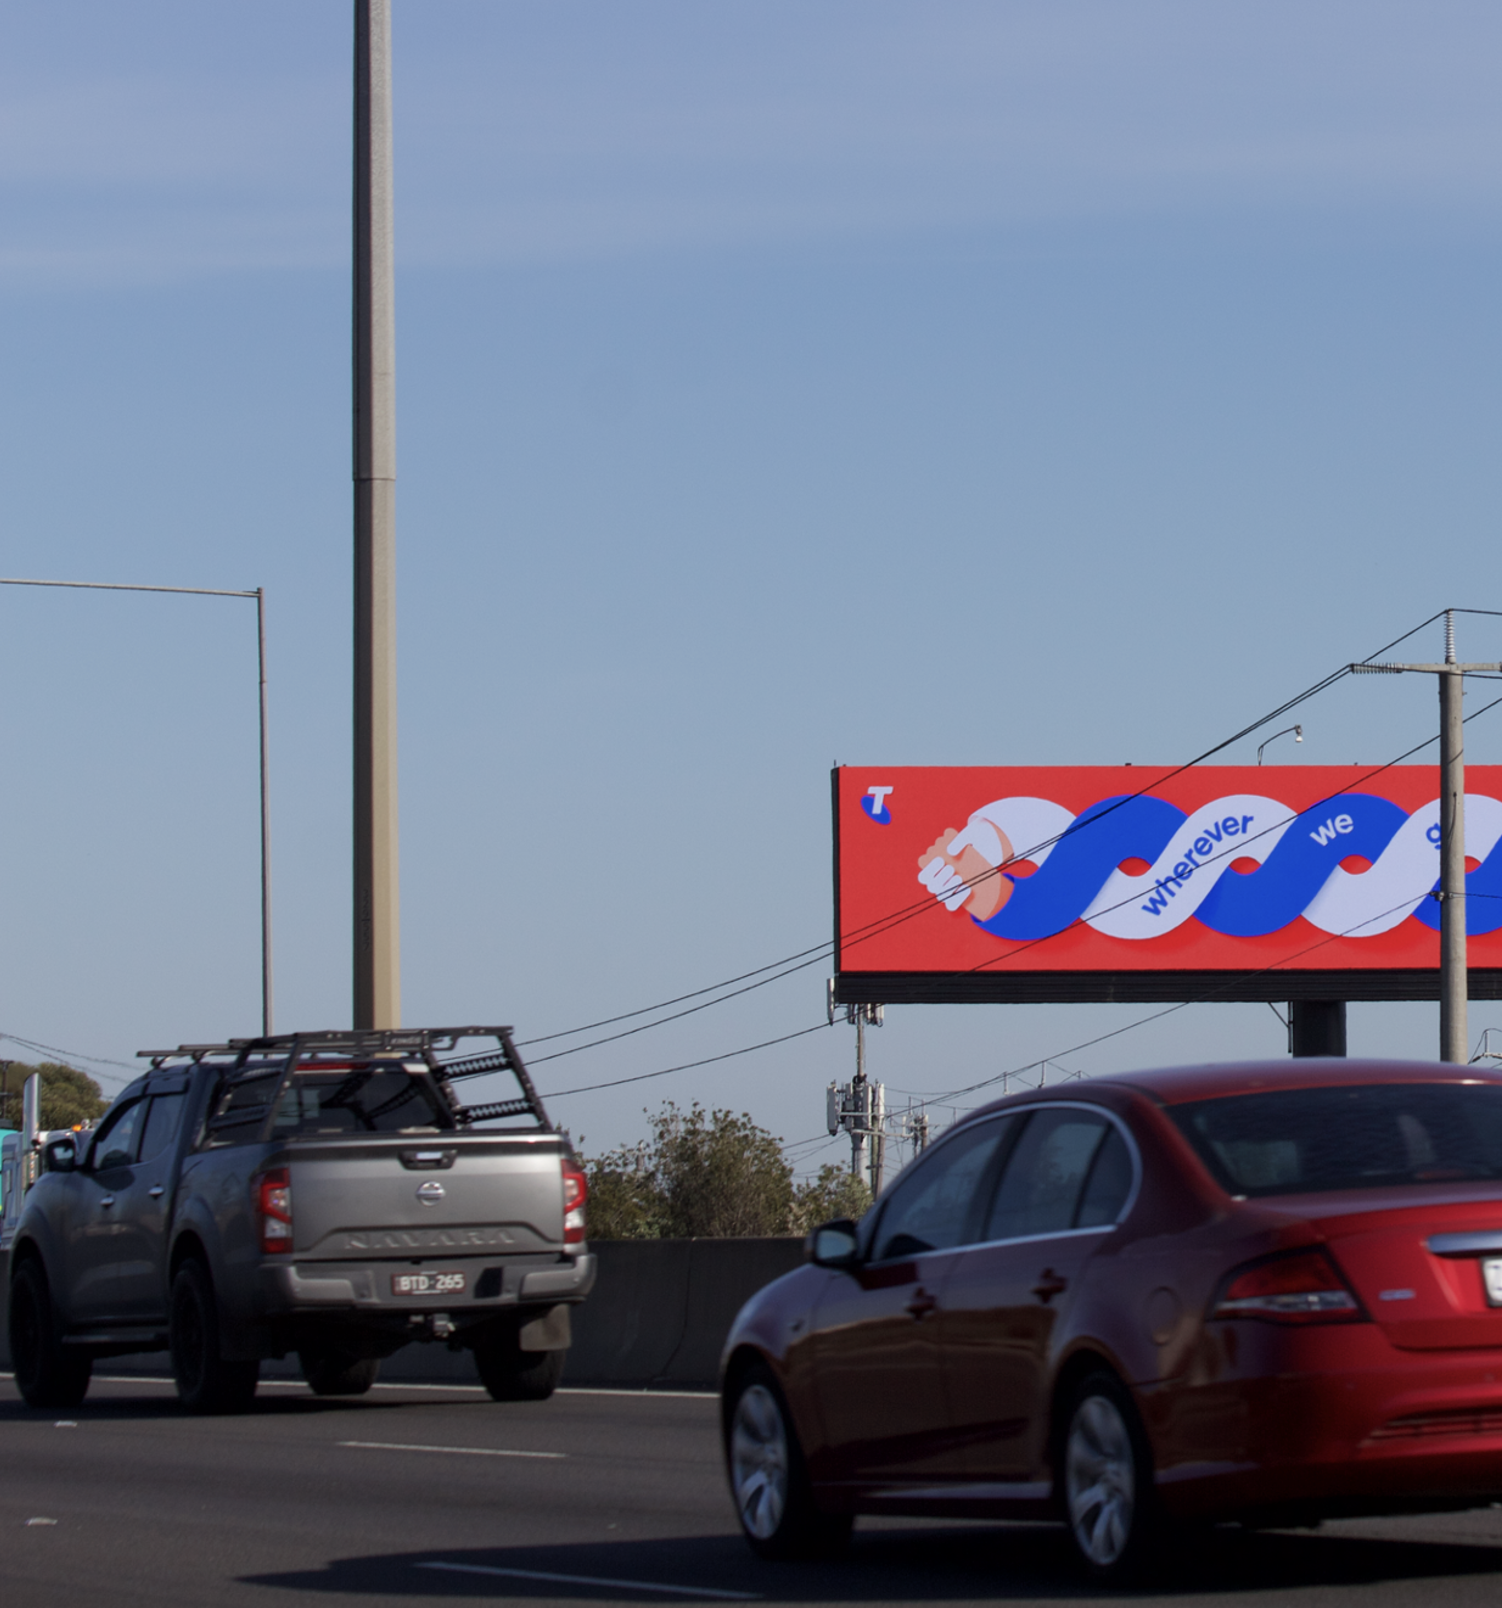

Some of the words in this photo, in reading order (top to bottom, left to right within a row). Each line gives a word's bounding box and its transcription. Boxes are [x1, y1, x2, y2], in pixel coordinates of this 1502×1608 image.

[867, 786, 894, 815] T
[1141, 815, 1254, 916] wherever
[1309, 813, 1354, 847] we
[1425, 822, 1441, 850] g
[344, 1229, 516, 1249] NAVARA
